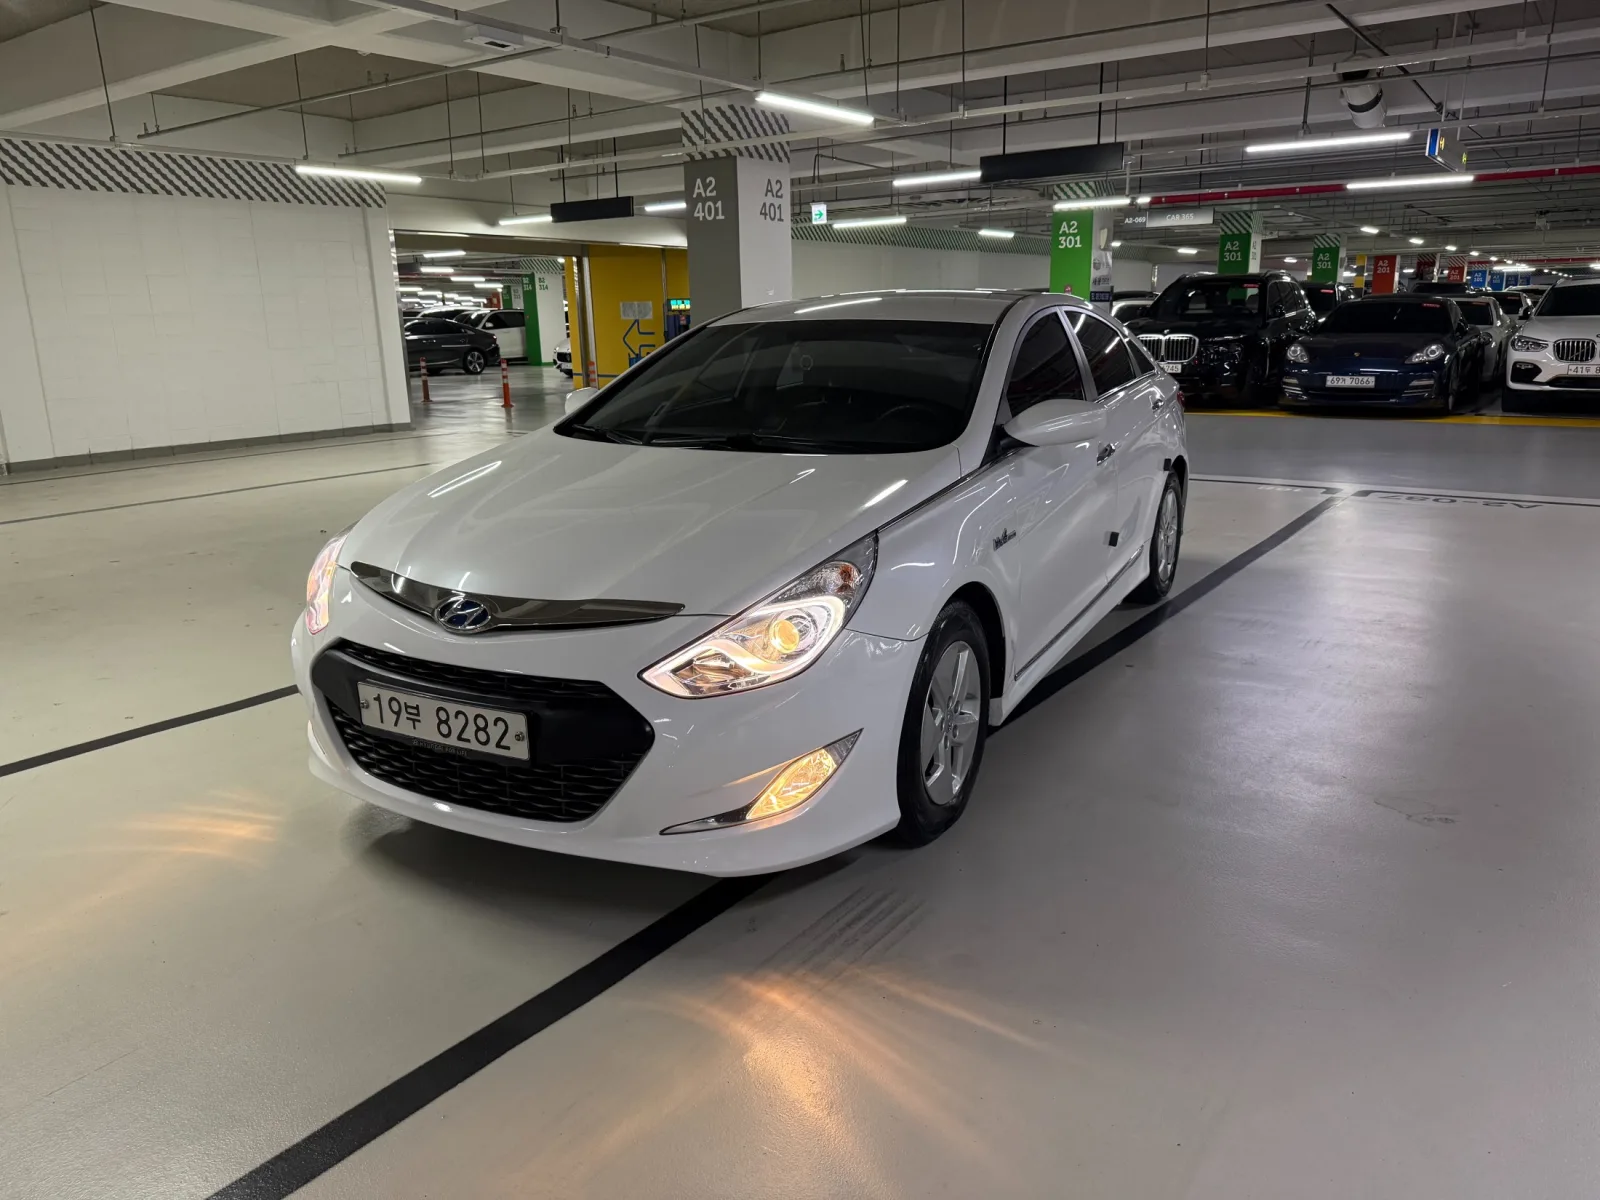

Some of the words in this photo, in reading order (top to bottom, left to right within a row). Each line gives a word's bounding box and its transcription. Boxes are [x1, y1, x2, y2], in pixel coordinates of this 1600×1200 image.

[692, 176, 717, 198] A2
[764, 178, 784, 199] A2
[693, 200, 725, 221] 401
[759, 202, 785, 223] 401
[1058, 220, 1078, 234] A2
[1124, 216, 1147, 224] A2-069
[1058, 235, 1082, 249] 301
[1224, 241, 1240, 251] A2
[1223, 251, 1242, 262] 301
[1317, 253, 1330, 261] A2
[1316, 261, 1332, 269] 301
[1349, 377, 1371, 385] 7066
[373, 693, 421, 730] 19부
[435, 706, 511, 751] 8282
